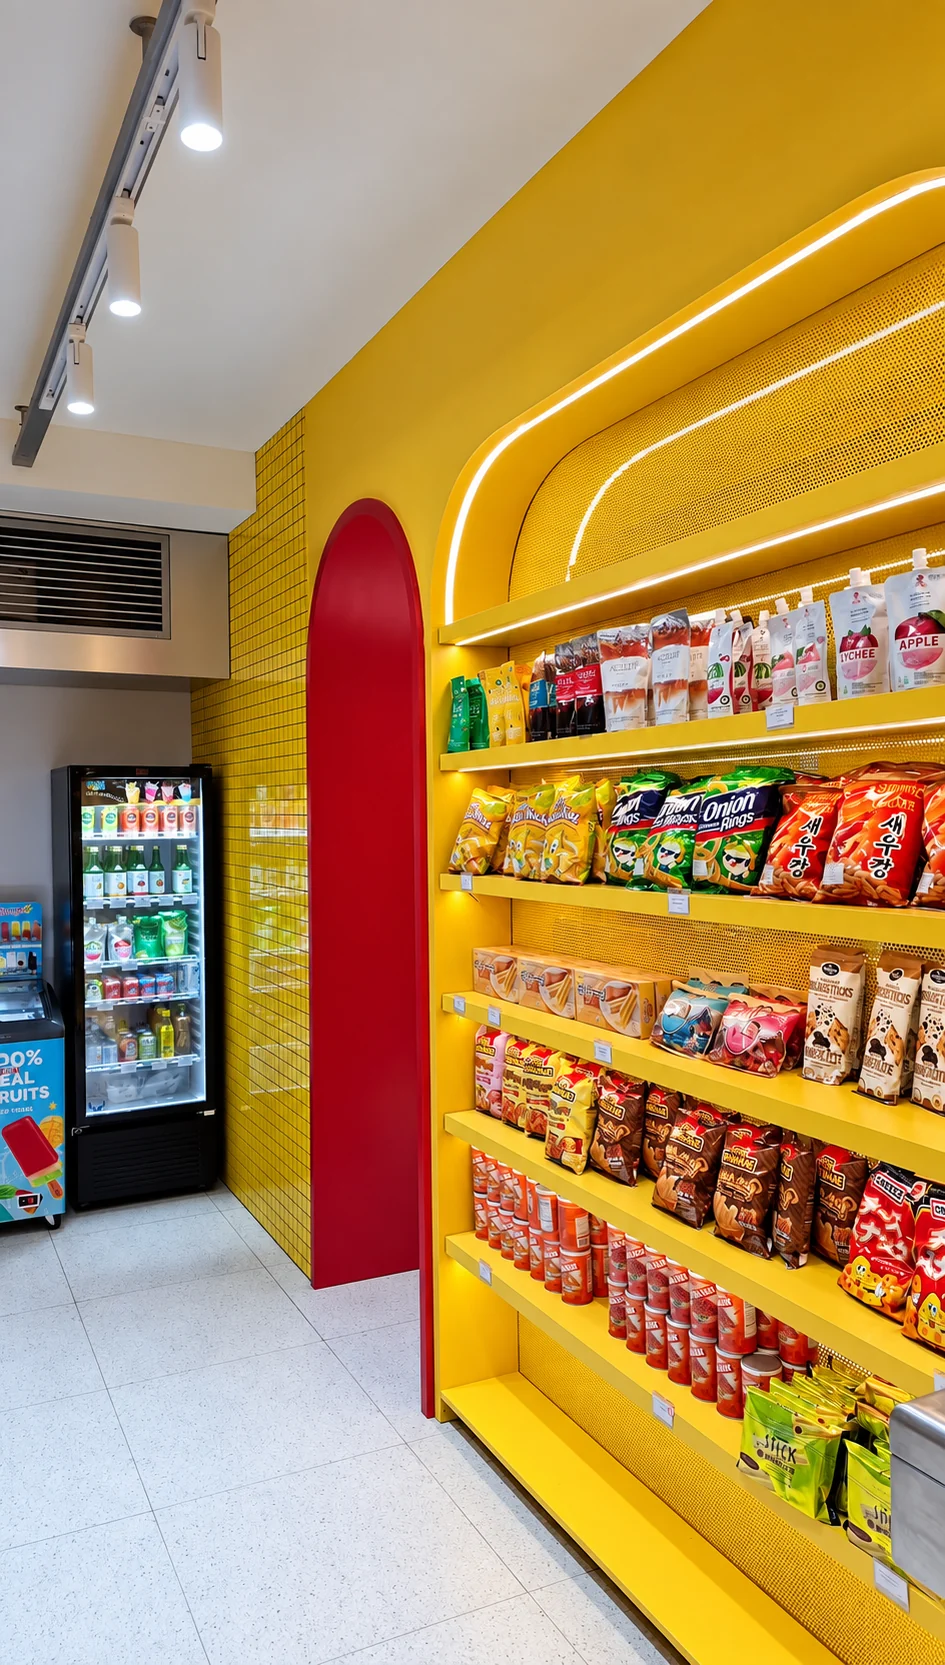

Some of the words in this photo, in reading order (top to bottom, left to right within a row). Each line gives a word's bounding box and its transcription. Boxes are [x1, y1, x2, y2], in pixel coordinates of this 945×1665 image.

[899, 635, 939, 651] APPLE
[840, 648, 875, 663] LYCHEE
[703, 791, 756, 822] Onion
[720, 811, 755, 832] Rings
[0, 1048, 43, 1068] 00%
[0, 1071, 35, 1087] EAL
[0, 1085, 50, 1104] RUITS
[764, 1433, 797, 1465] STICK
